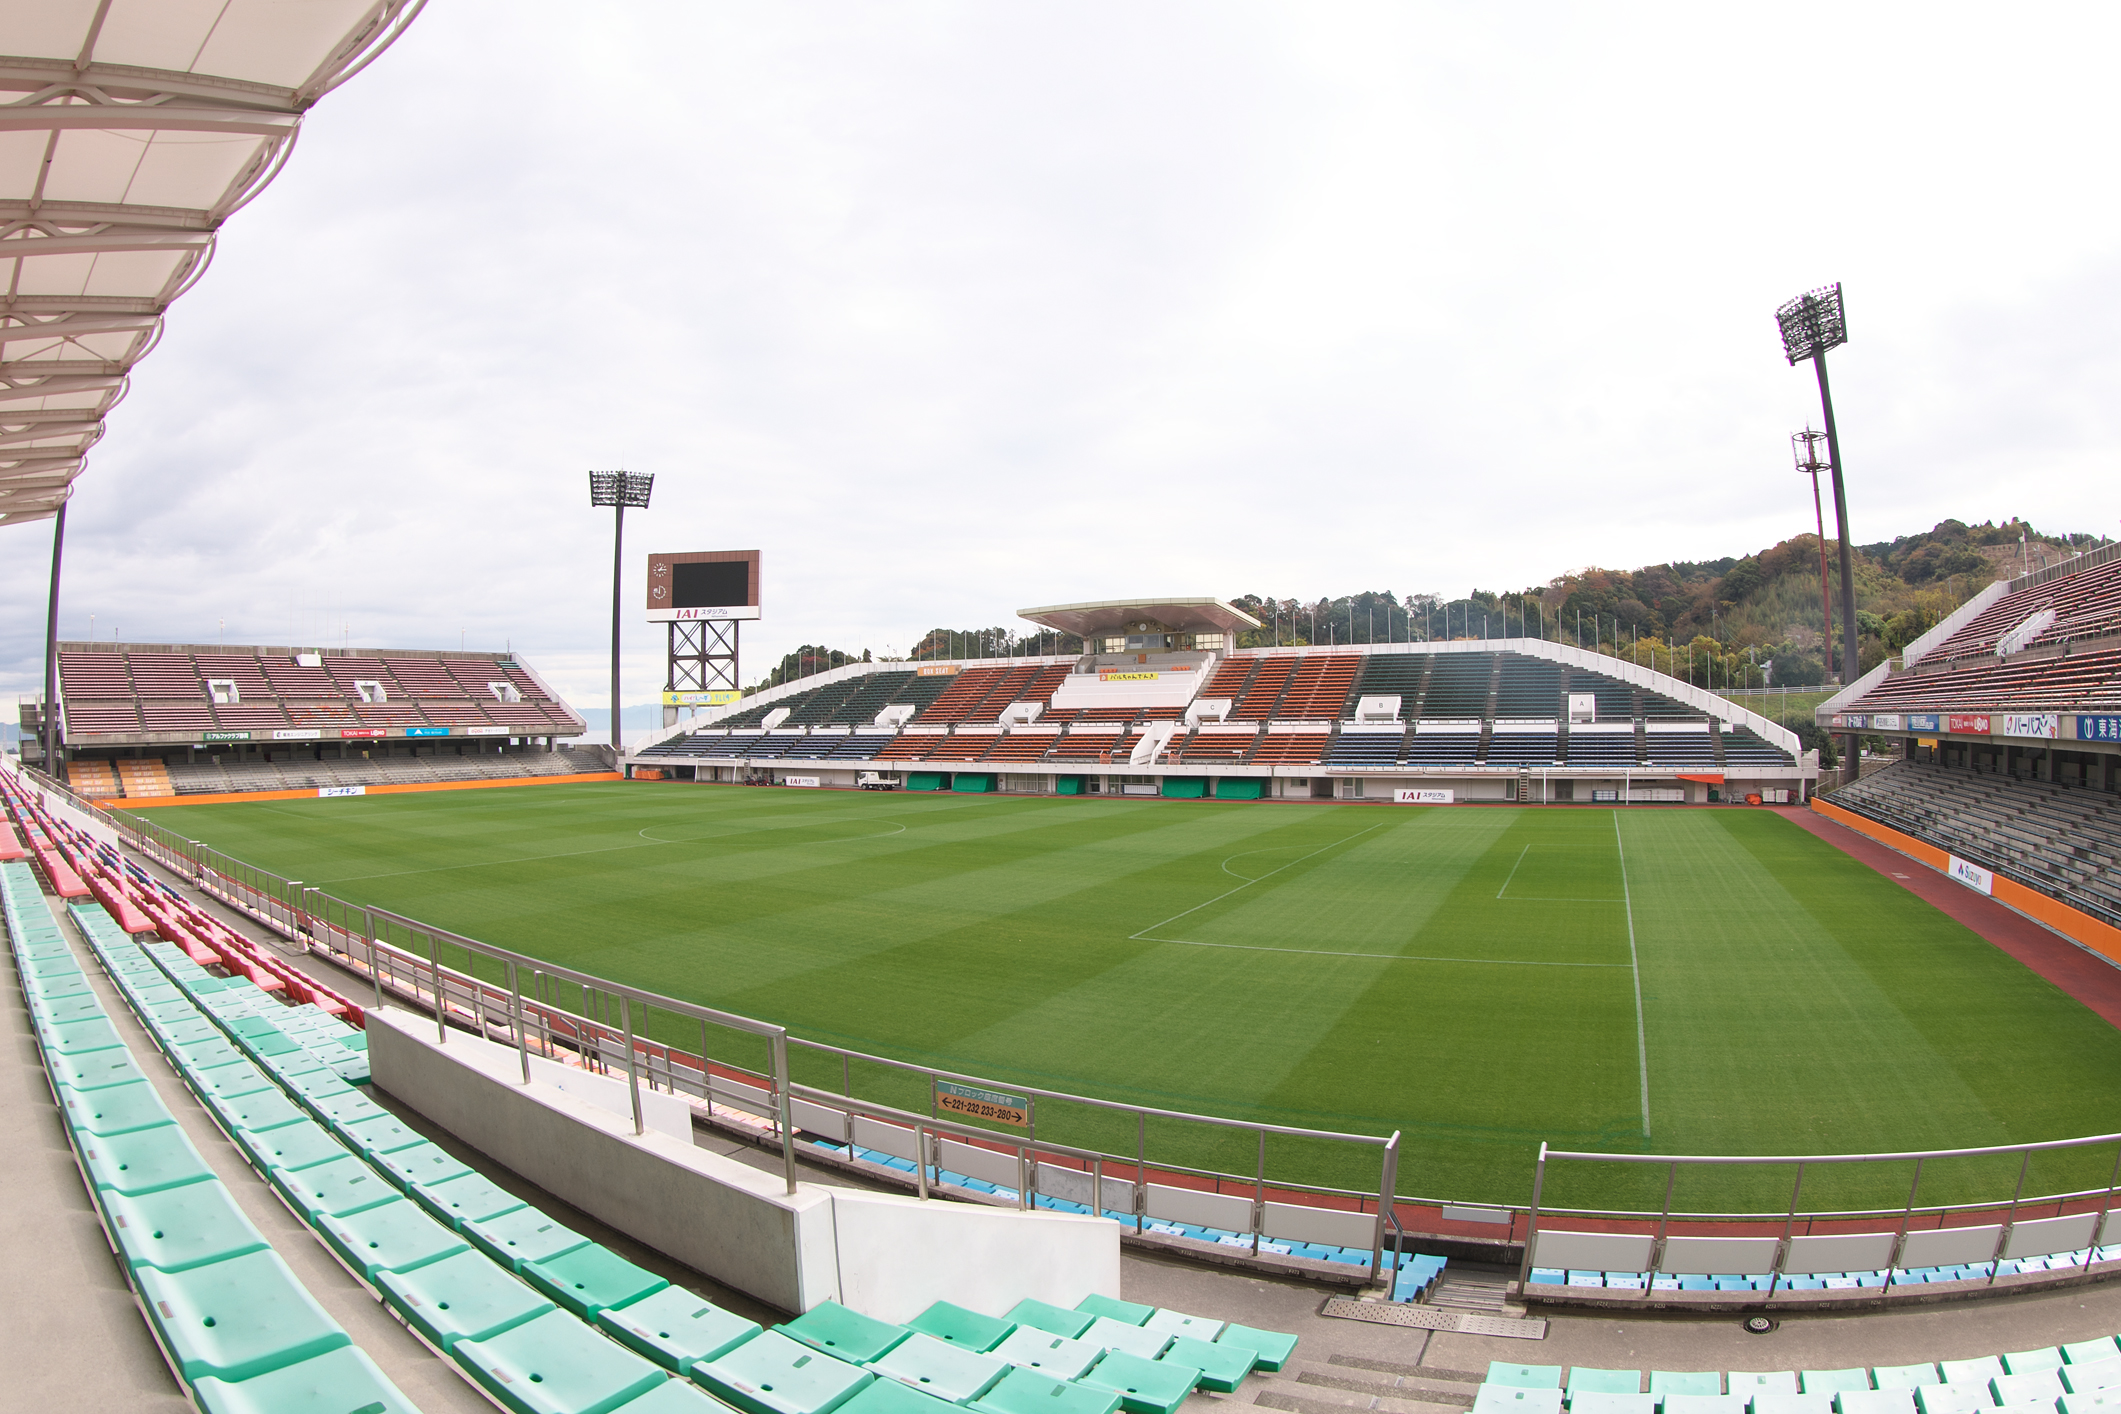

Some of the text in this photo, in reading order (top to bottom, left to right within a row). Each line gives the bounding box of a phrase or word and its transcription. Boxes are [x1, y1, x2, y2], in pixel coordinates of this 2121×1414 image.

[676, 609, 698, 618] IAI
[1951, 718, 1963, 729] TOKAI
[2098, 718, 2121, 738] 東海
[1965, 865, 1982, 885] Suzuyo
[952, 1099, 1011, 1120] 221-232 233-280
